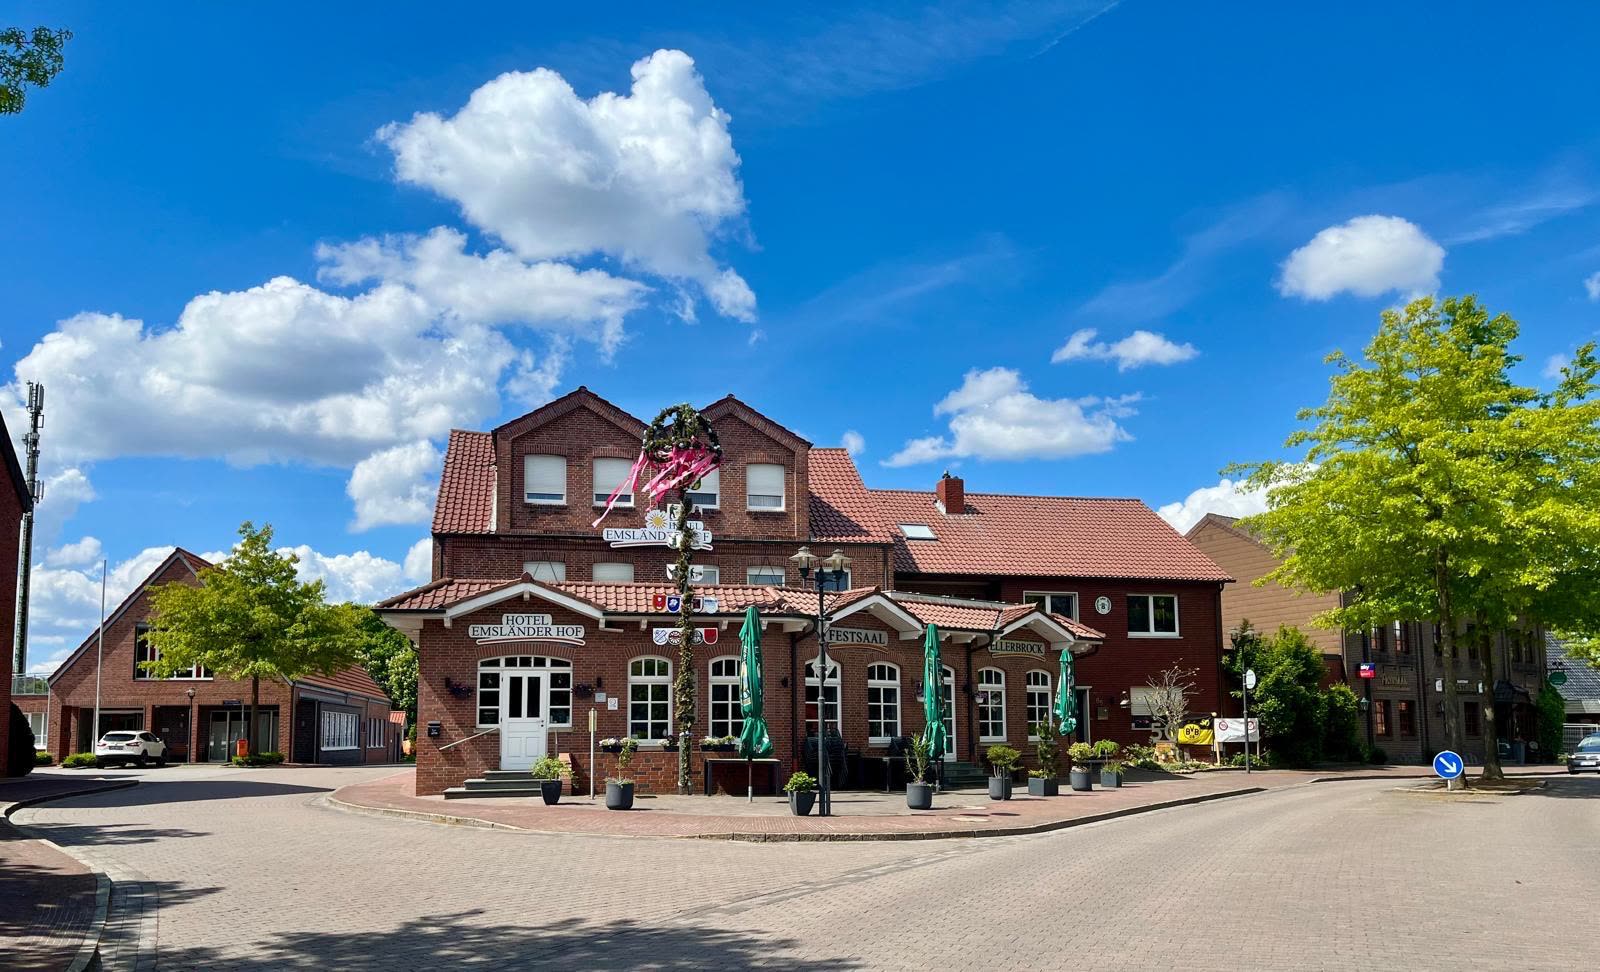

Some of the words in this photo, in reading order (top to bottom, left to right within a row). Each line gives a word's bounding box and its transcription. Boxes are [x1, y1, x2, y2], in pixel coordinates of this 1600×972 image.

[506, 615, 549, 625] HOTEL
[471, 625, 553, 637] EMSLÄNDER
[556, 626, 583, 637] HOF
[829, 629, 885, 644] FESTSAAL
[990, 641, 1043, 654] ELLERBROCK
